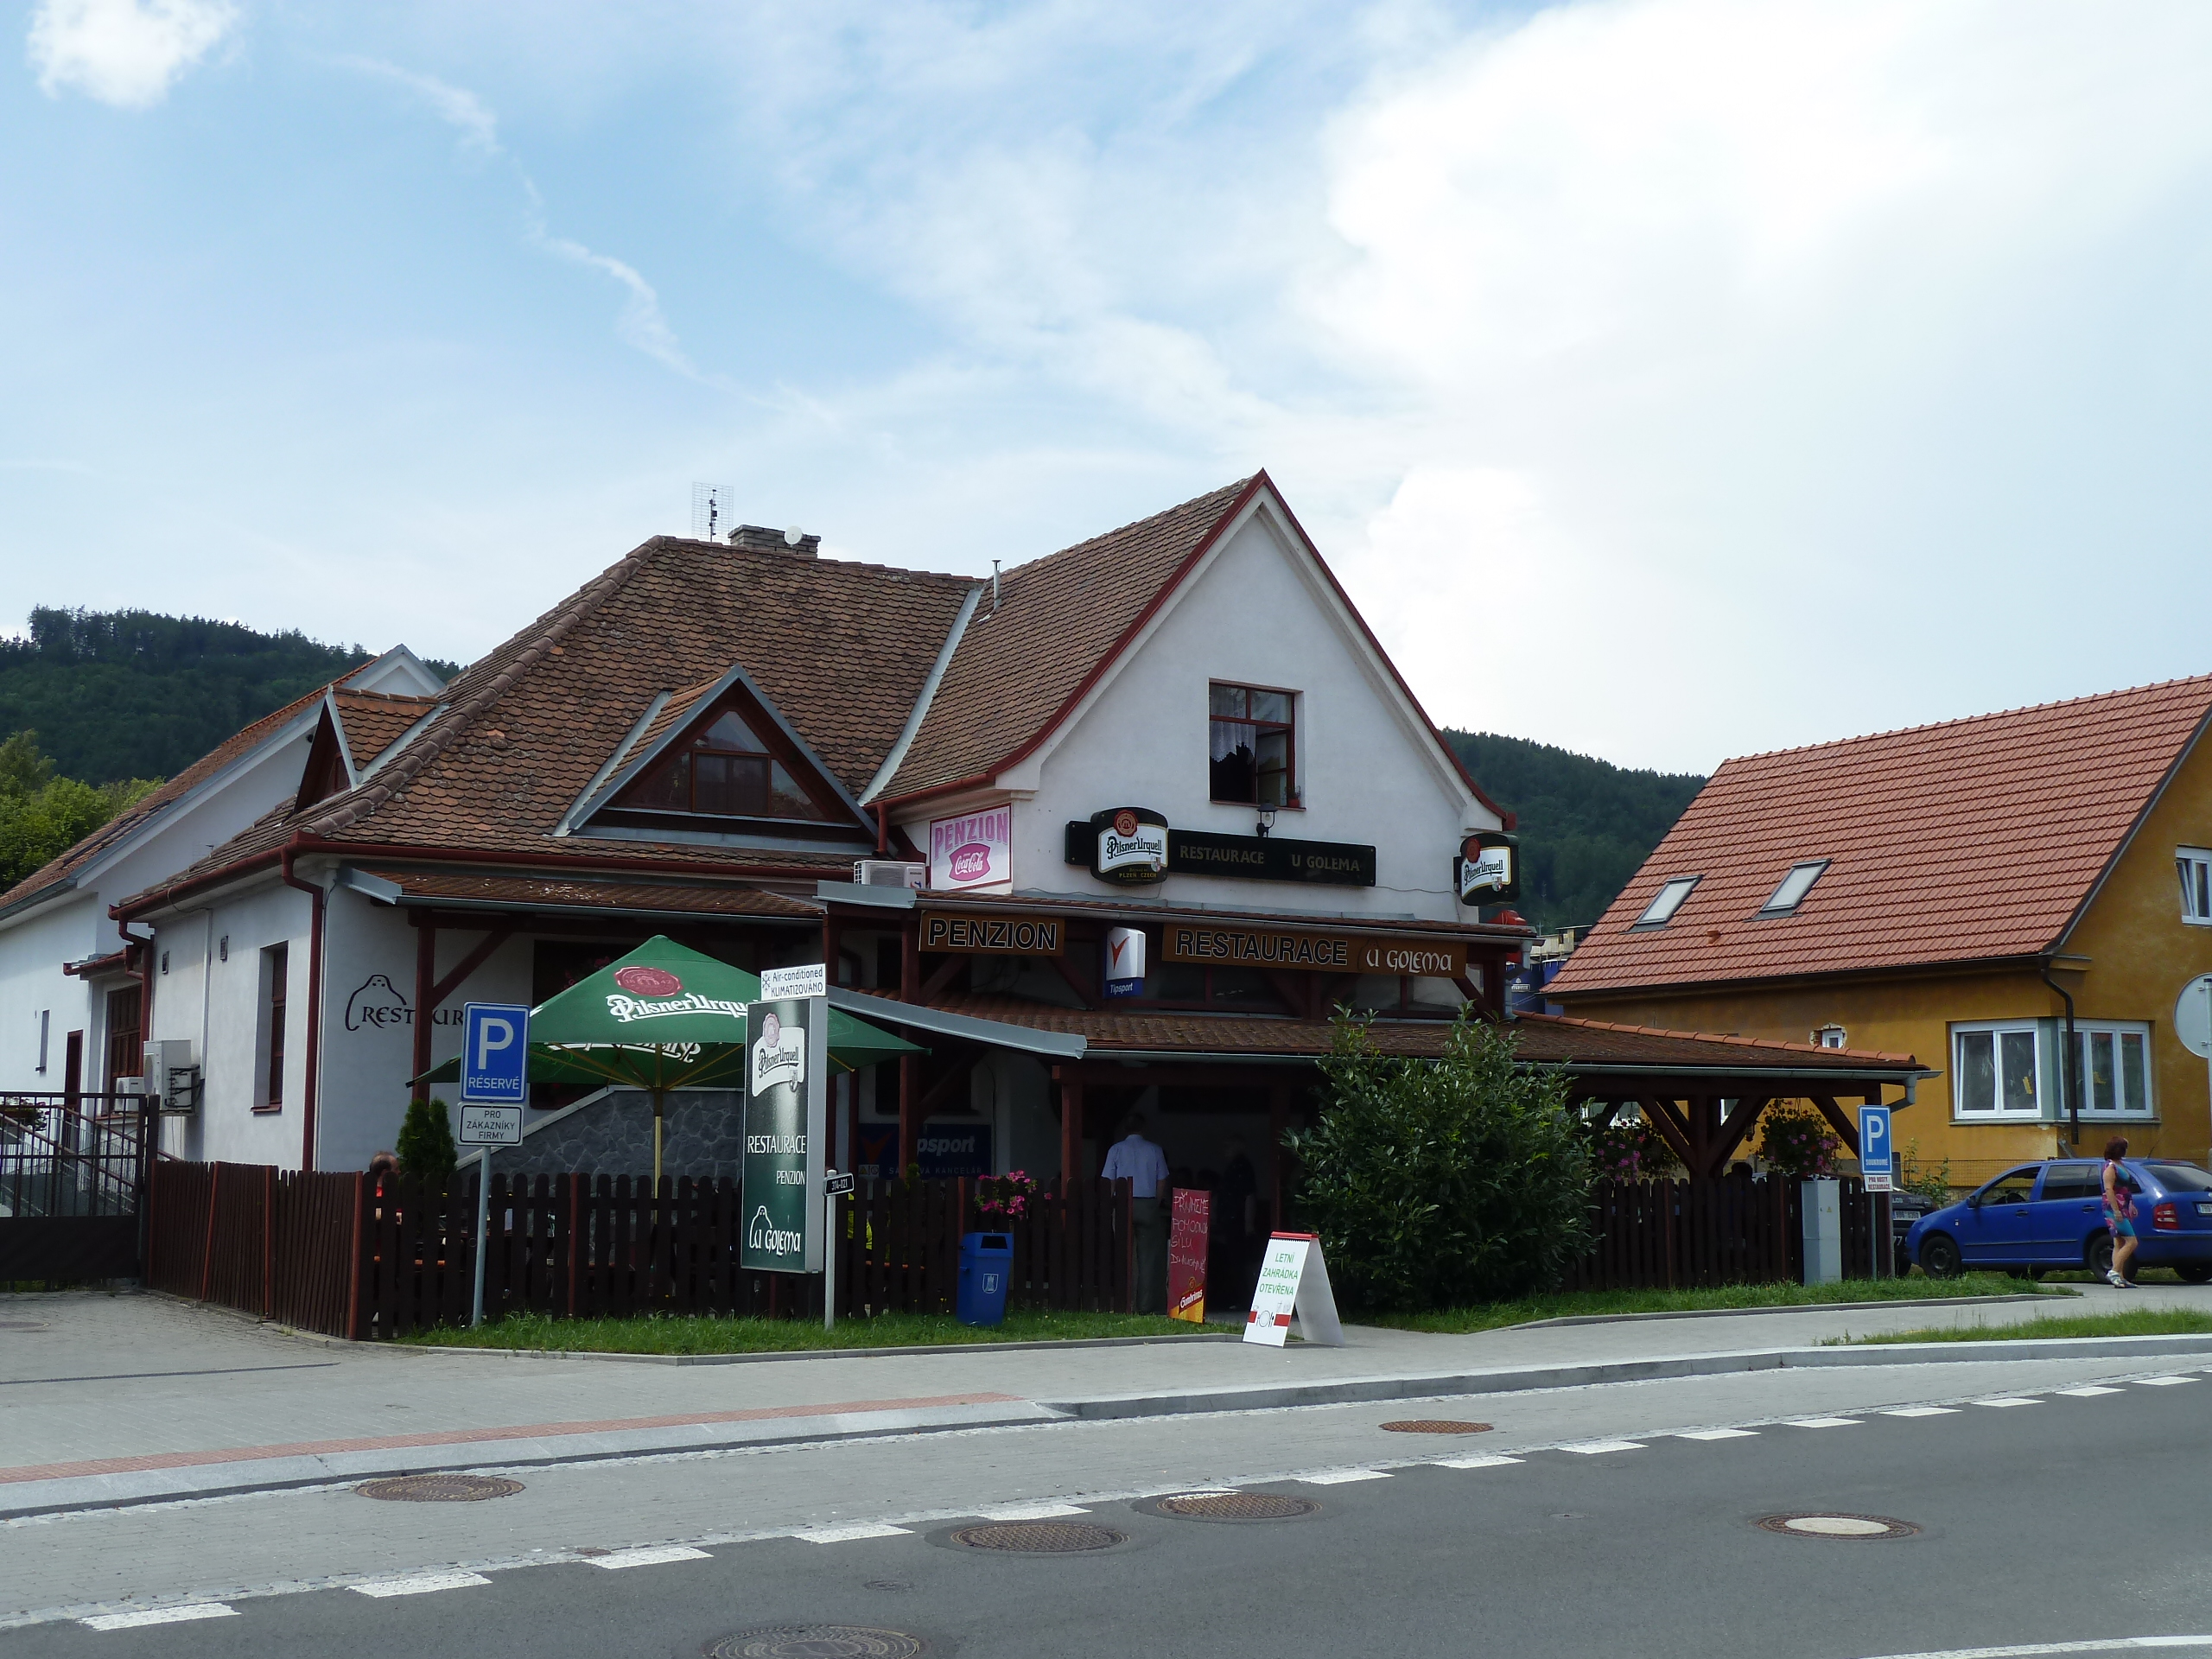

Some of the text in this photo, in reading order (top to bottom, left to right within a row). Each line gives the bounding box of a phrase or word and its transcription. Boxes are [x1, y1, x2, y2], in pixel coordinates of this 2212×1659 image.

[934, 813, 1008, 861] PENZION
[1107, 836, 1161, 860] Pilsner Urquell
[1179, 845, 1360, 872] RESTAURACE U GOLEMA
[1464, 860, 1503, 887] Pilsner Urquell
[928, 918, 1057, 950] PENZION
[1175, 929, 1348, 966] RESTAURACE
[772, 967, 823, 982] Air-conditioned
[771, 980, 823, 997] KLIMATIZOVÁNO
[1110, 982, 1133, 995] Tipsport
[362, 1006, 464, 1028] RESTUR
[606, 992, 747, 1023] Pilsner Urqu
[478, 1017, 514, 1071] P
[758, 1046, 799, 1078] Pilsner Urquell
[467, 1076, 520, 1090] RÉSERVÉ
[484, 1109, 501, 1119] PRO
[466, 1121, 516, 1130] ZÁKAZNÍKY
[478, 1131, 505, 1140] FIRMY
[1866, 1115, 1885, 1153] P
[747, 1135, 806, 1154] RESTAURACE
[917, 1135, 976, 1156] psport
[776, 1170, 806, 1185] PENZION
[1274, 1252, 1295, 1263] LETNÍ
[1262, 1268, 1298, 1280] ZAHRÁDKA
[1259, 1282, 1294, 1295] OTEVŘENA
